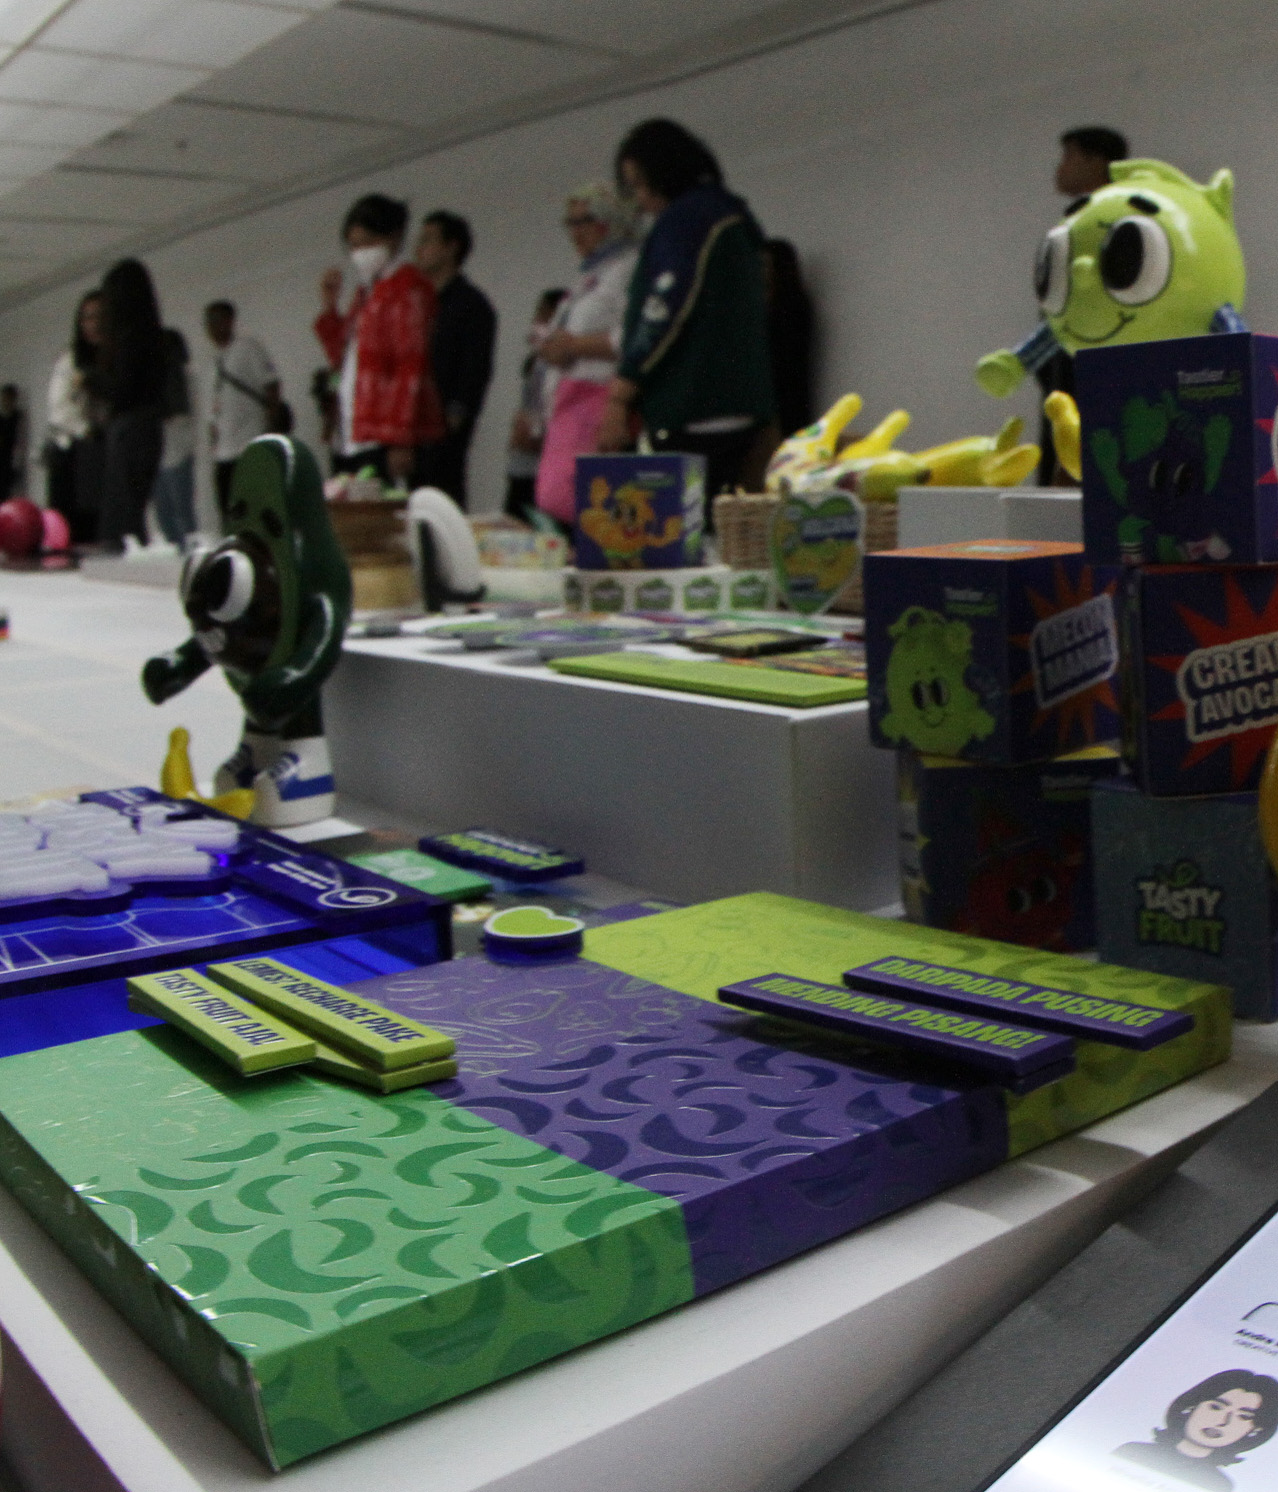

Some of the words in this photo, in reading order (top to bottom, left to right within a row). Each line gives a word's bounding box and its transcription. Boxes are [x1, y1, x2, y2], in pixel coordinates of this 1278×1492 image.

[1138, 879, 1221, 921] TASTY
[1138, 918, 1225, 955] FRUIT
[153, 972, 209, 1002] TASTY
[190, 994, 254, 1026] FRUIT
[226, 1021, 287, 1047] AJA!
[280, 982, 377, 1023] RECHARGE
[357, 1013, 426, 1043] PAKE
[751, 977, 901, 1019] MENDING
[900, 1008, 1047, 1050] PISANG!
[868, 959, 1022, 1007] DARIPADA
[1021, 988, 1165, 1029] PUSING
